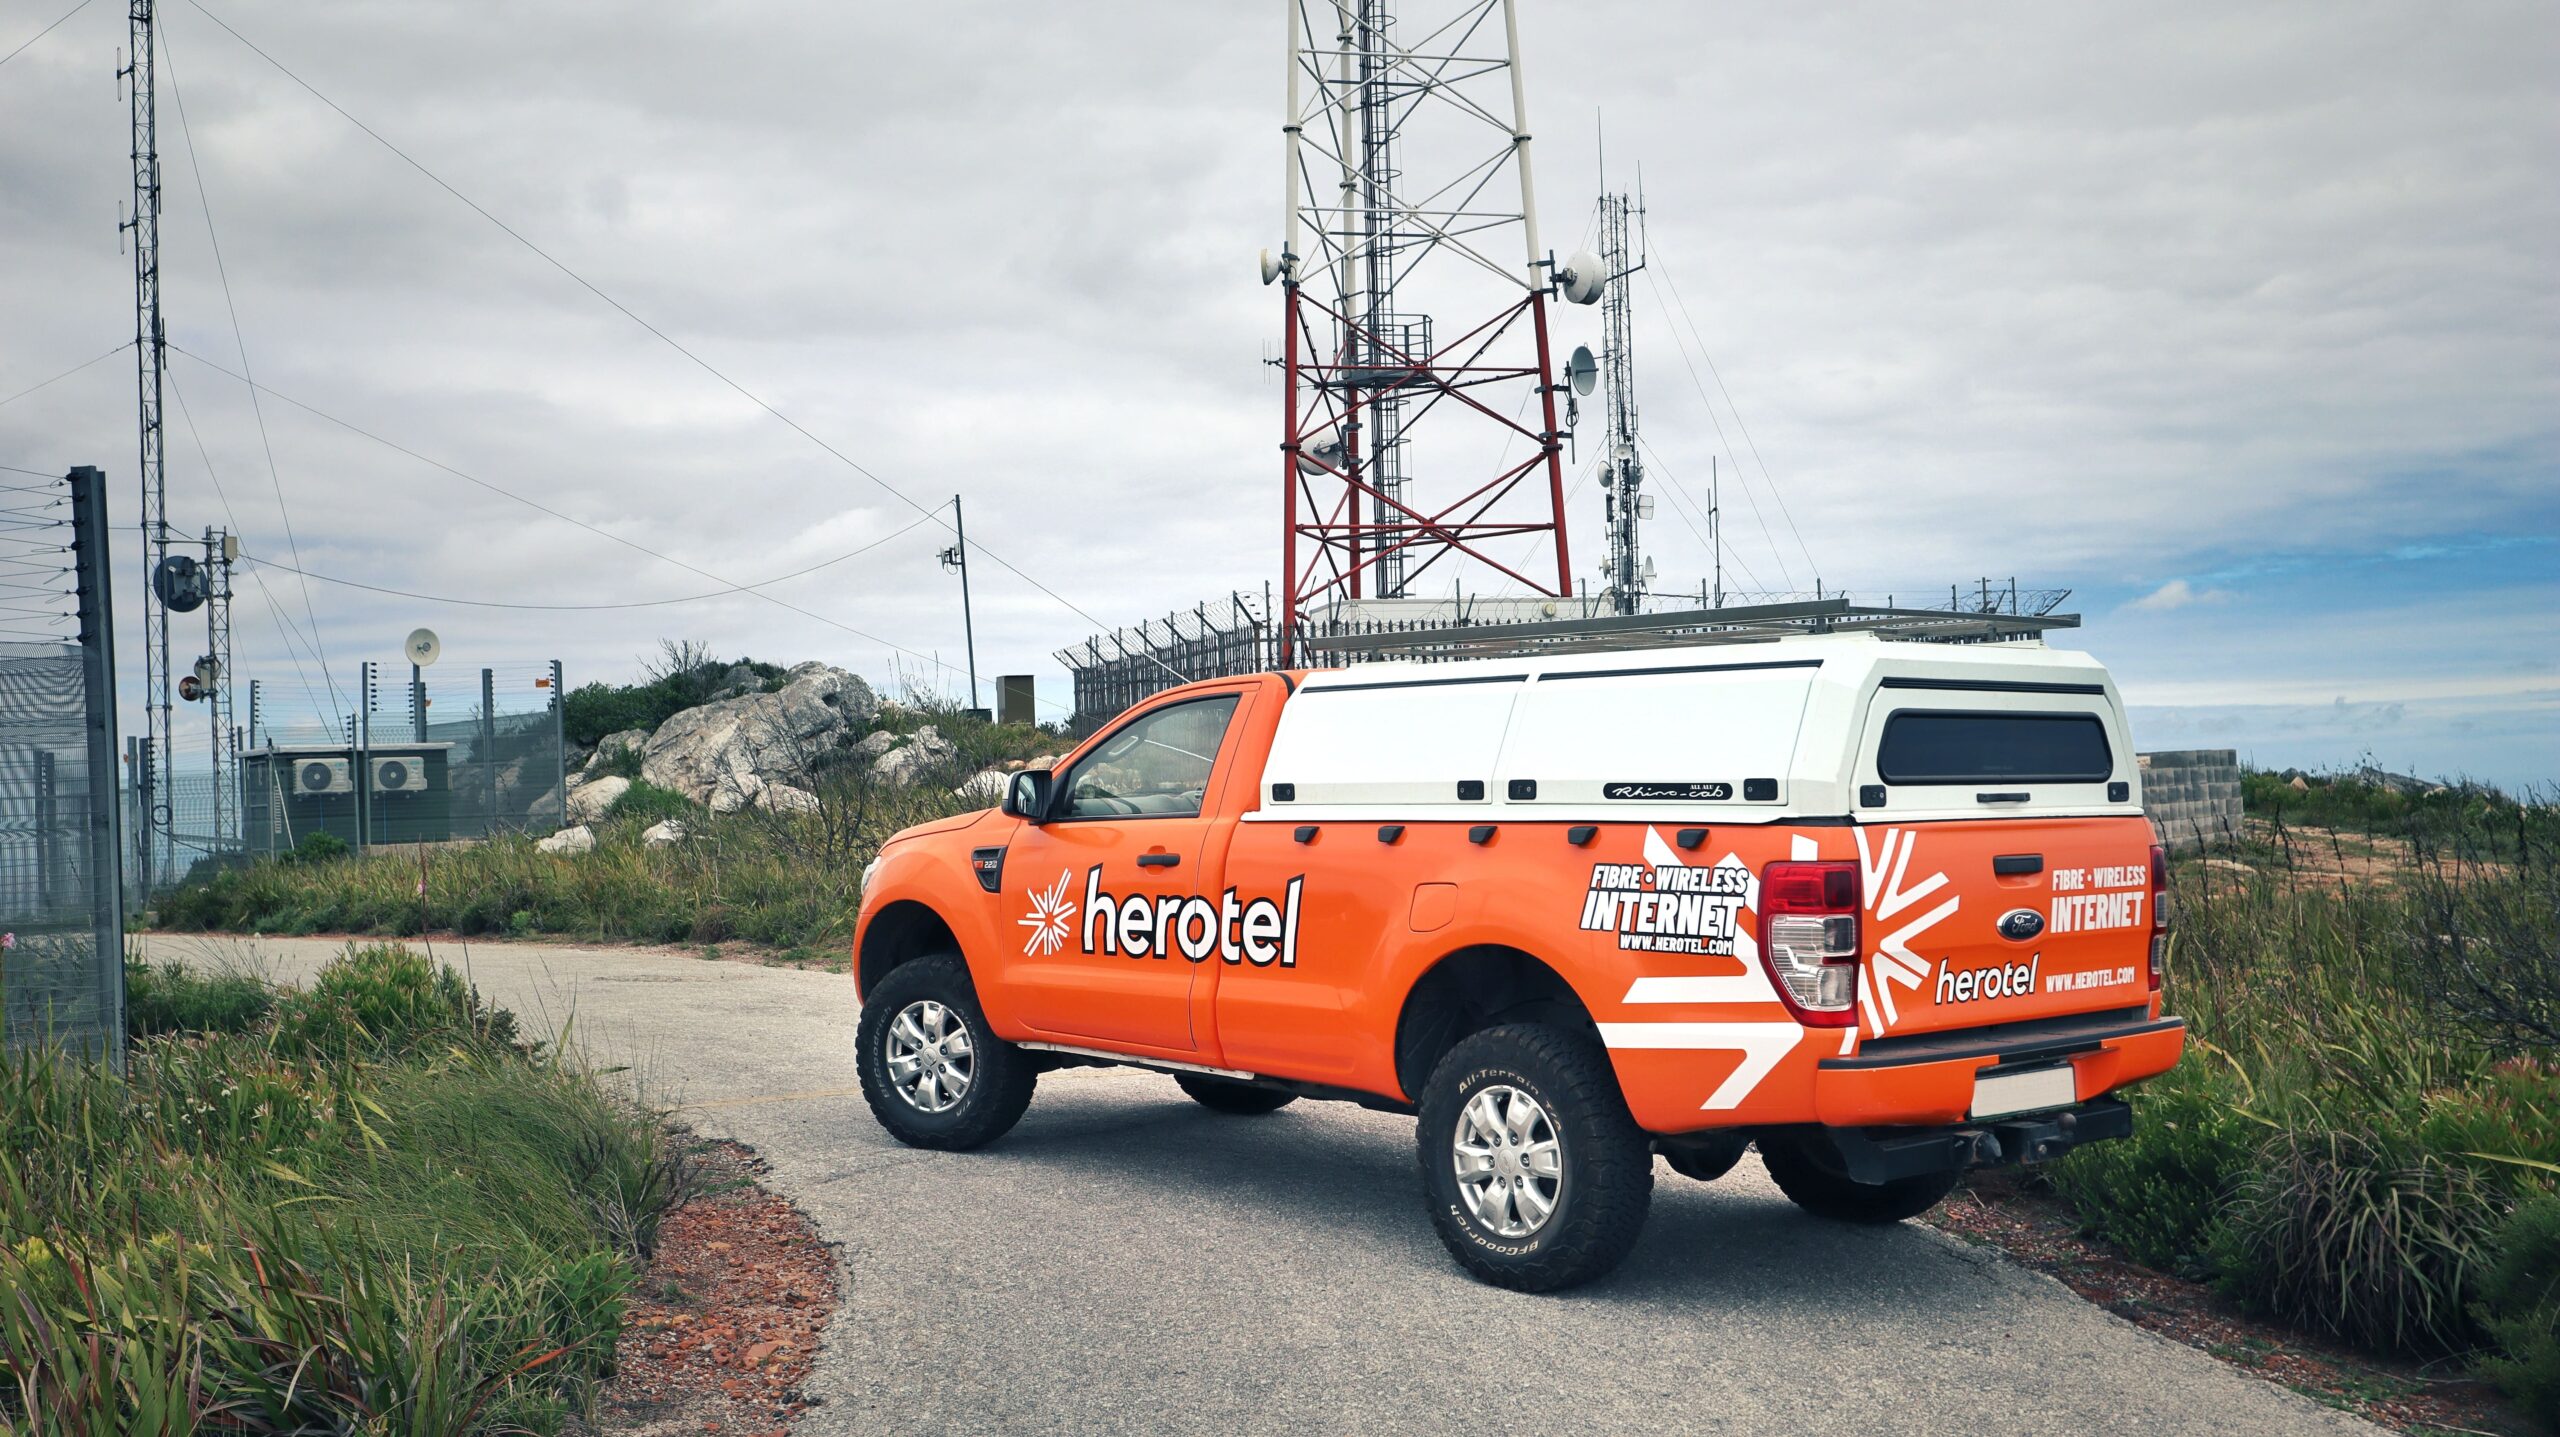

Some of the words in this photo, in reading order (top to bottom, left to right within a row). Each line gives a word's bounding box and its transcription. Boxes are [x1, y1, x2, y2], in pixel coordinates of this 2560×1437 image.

[1590, 863, 1645, 890] FIBRE
[1654, 865, 1749, 894] WIRELESS
[2052, 868, 2085, 891] FIBRE
[2093, 865, 2146, 889] WIRELESS
[1082, 863, 1305, 967] herotel
[1579, 889, 1746, 939] INTERNET
[2011, 913, 2039, 934] Ford
[2050, 891, 2145, 933] INTERNET
[1619, 934, 1733, 956] WWW.HEROTEL.COM
[1935, 952, 2040, 1005] herotel
[2046, 966, 2135, 993] WWW.HEROTEL.COM
[1451, 1204, 1540, 1256] BFGoodrich
